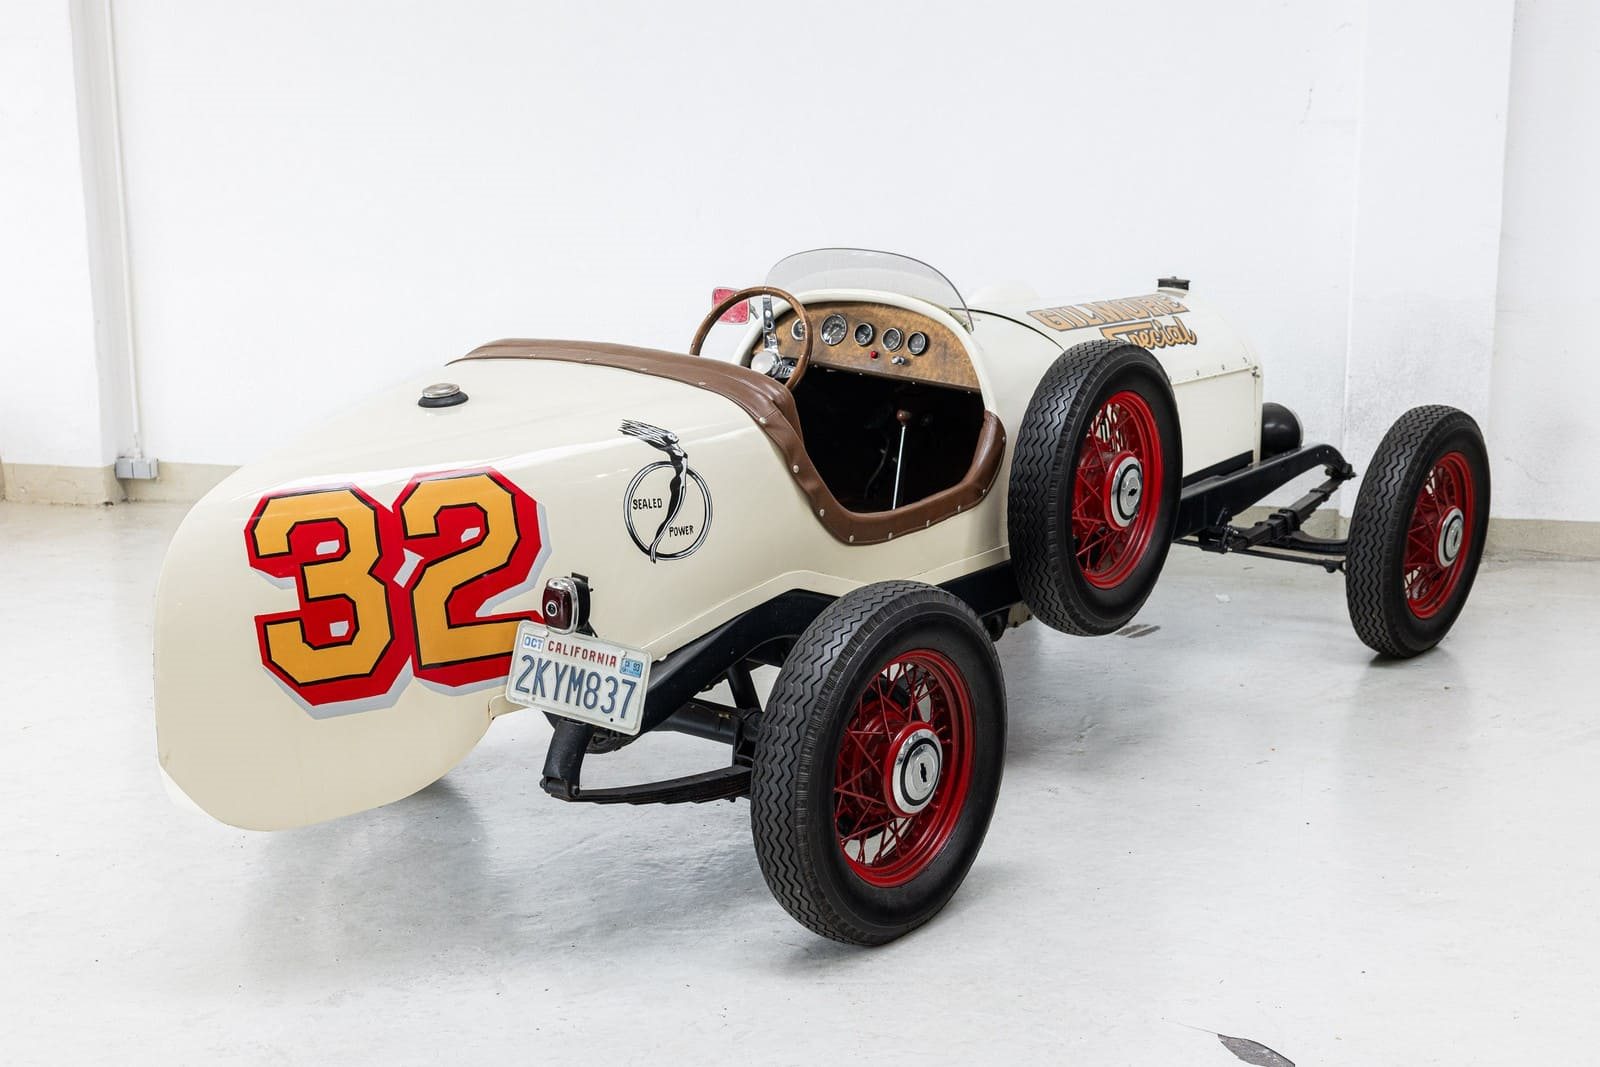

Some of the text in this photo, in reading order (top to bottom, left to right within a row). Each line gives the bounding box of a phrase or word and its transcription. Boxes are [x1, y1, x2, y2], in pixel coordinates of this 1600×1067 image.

[1026, 294, 1190, 332] GILMORE
[632, 498, 662, 510] SEALED
[669, 525, 694, 537] POWER
[244, 466, 549, 713] 32
[524, 635, 543, 650] OCT
[547, 640, 617, 668] CALIFORNIA
[515, 654, 637, 719] 2KYM837
